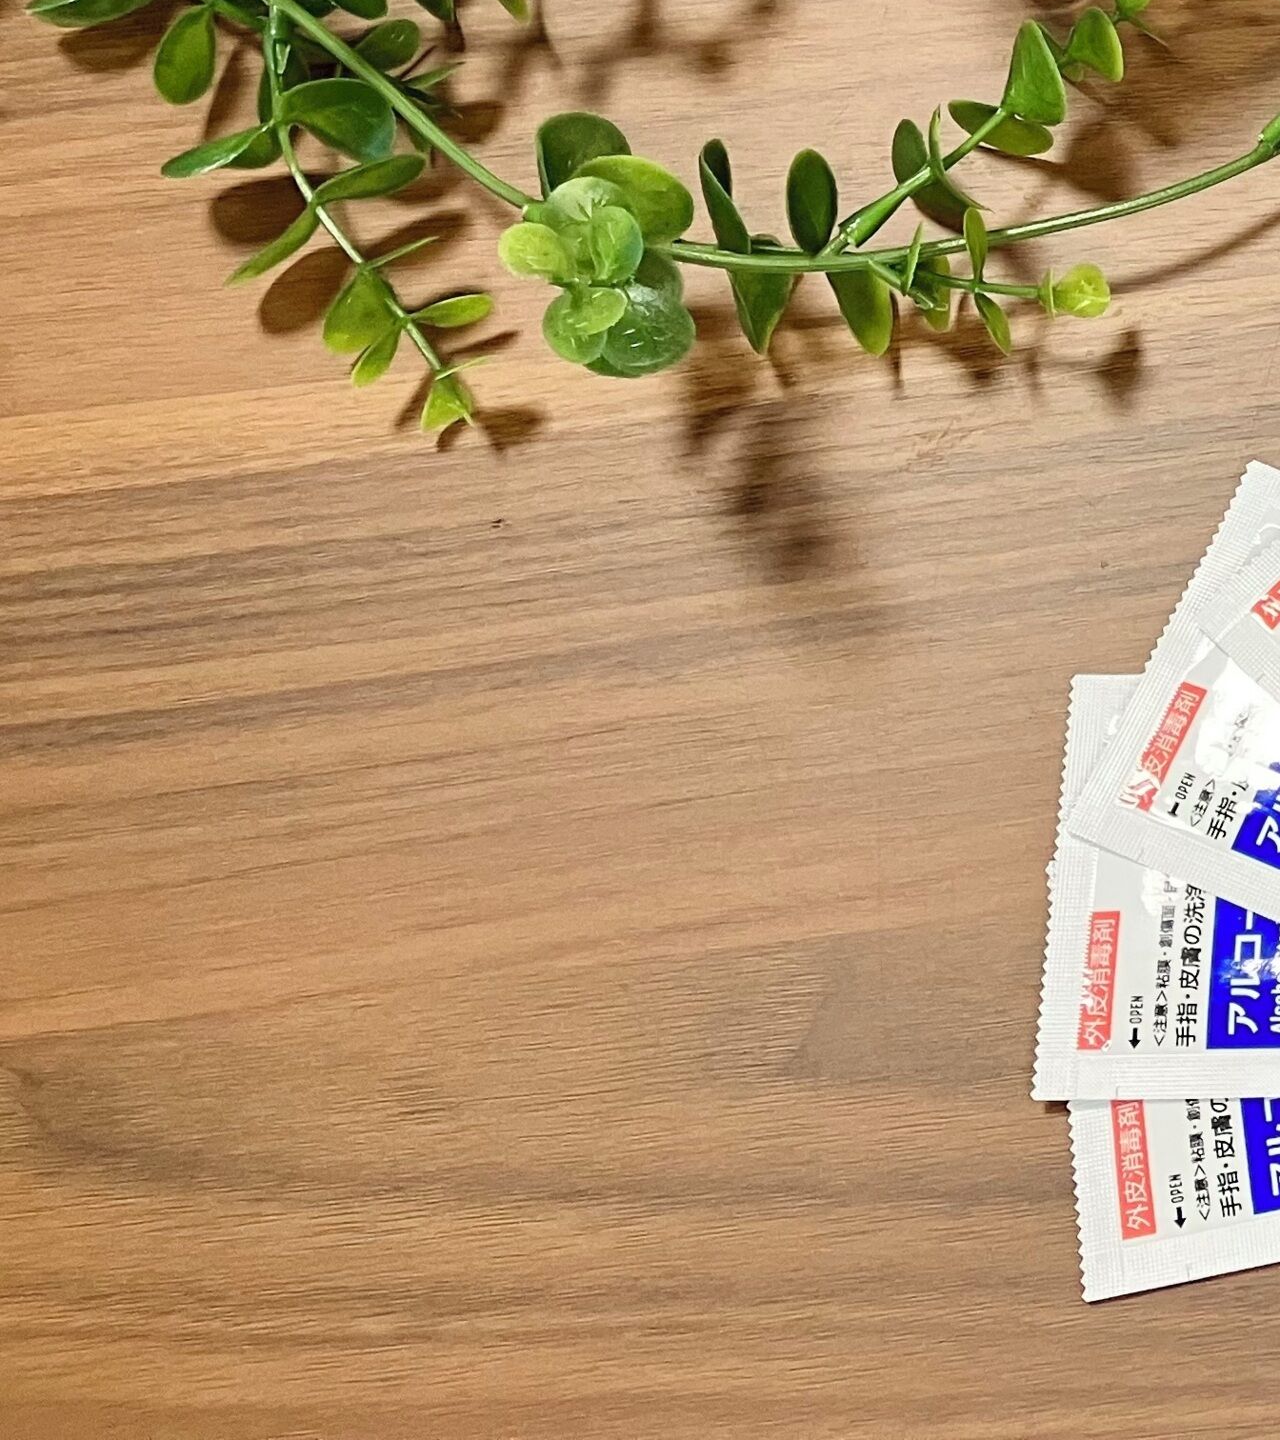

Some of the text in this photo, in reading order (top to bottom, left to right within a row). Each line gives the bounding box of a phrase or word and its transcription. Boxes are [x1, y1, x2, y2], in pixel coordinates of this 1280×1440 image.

[1175, 772, 1196, 800] OPEN
[1129, 995, 1144, 1024] OPEN
[1169, 1173, 1185, 1204] OPEN
